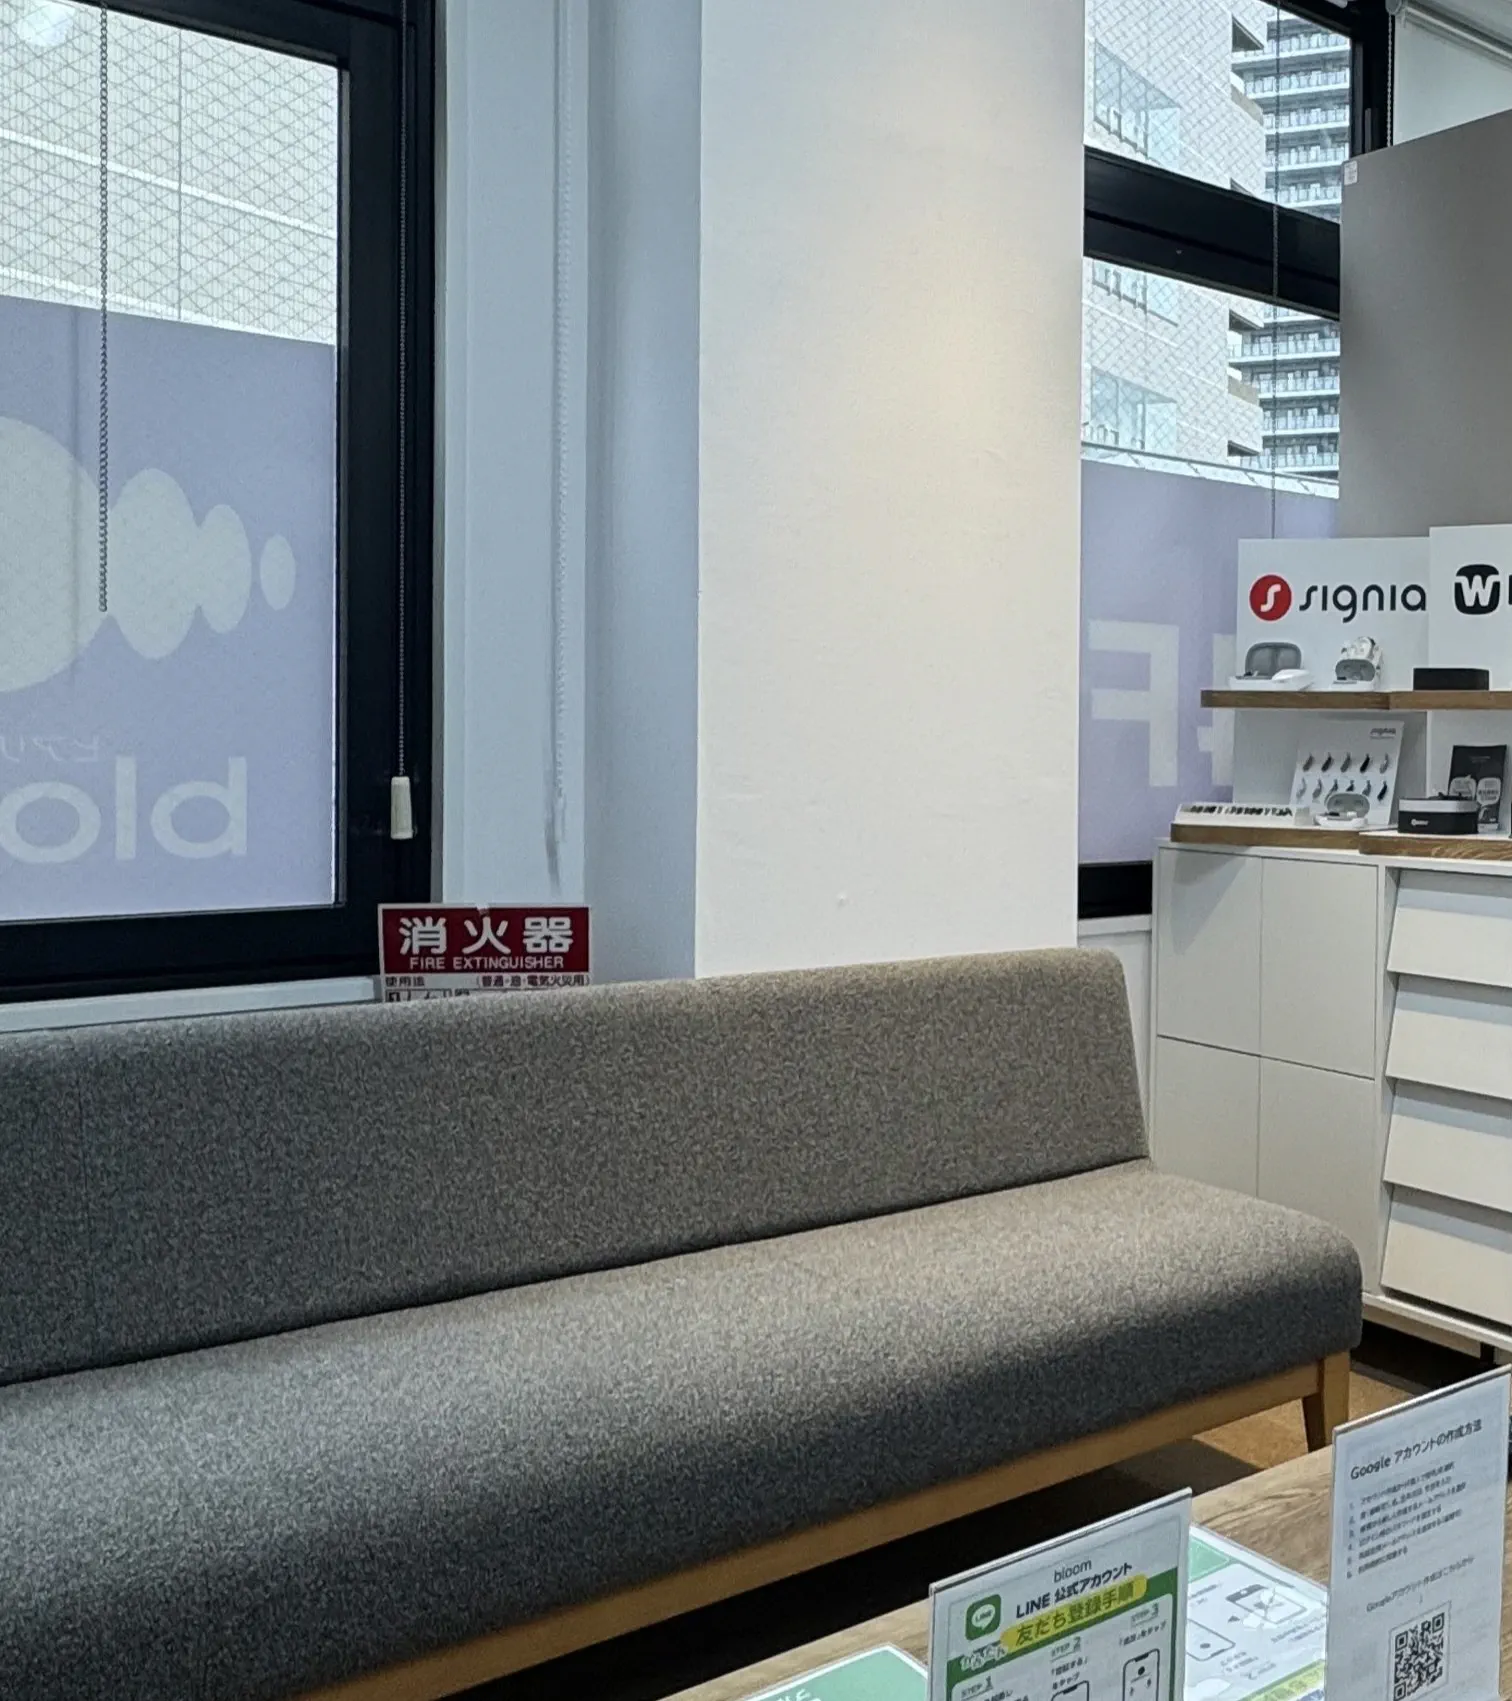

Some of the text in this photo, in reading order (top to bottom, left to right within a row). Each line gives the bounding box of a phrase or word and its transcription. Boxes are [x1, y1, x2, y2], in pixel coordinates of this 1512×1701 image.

[1298, 584, 1427, 624] signia
[398, 916, 574, 955] 消火器
[409, 955, 564, 970] FIRE EXTINGUISHER
[1350, 1454, 1392, 1480] Google
[1053, 1559, 1092, 1583] bloom
[1016, 1561, 1133, 1619] LINE 公式アカウント
